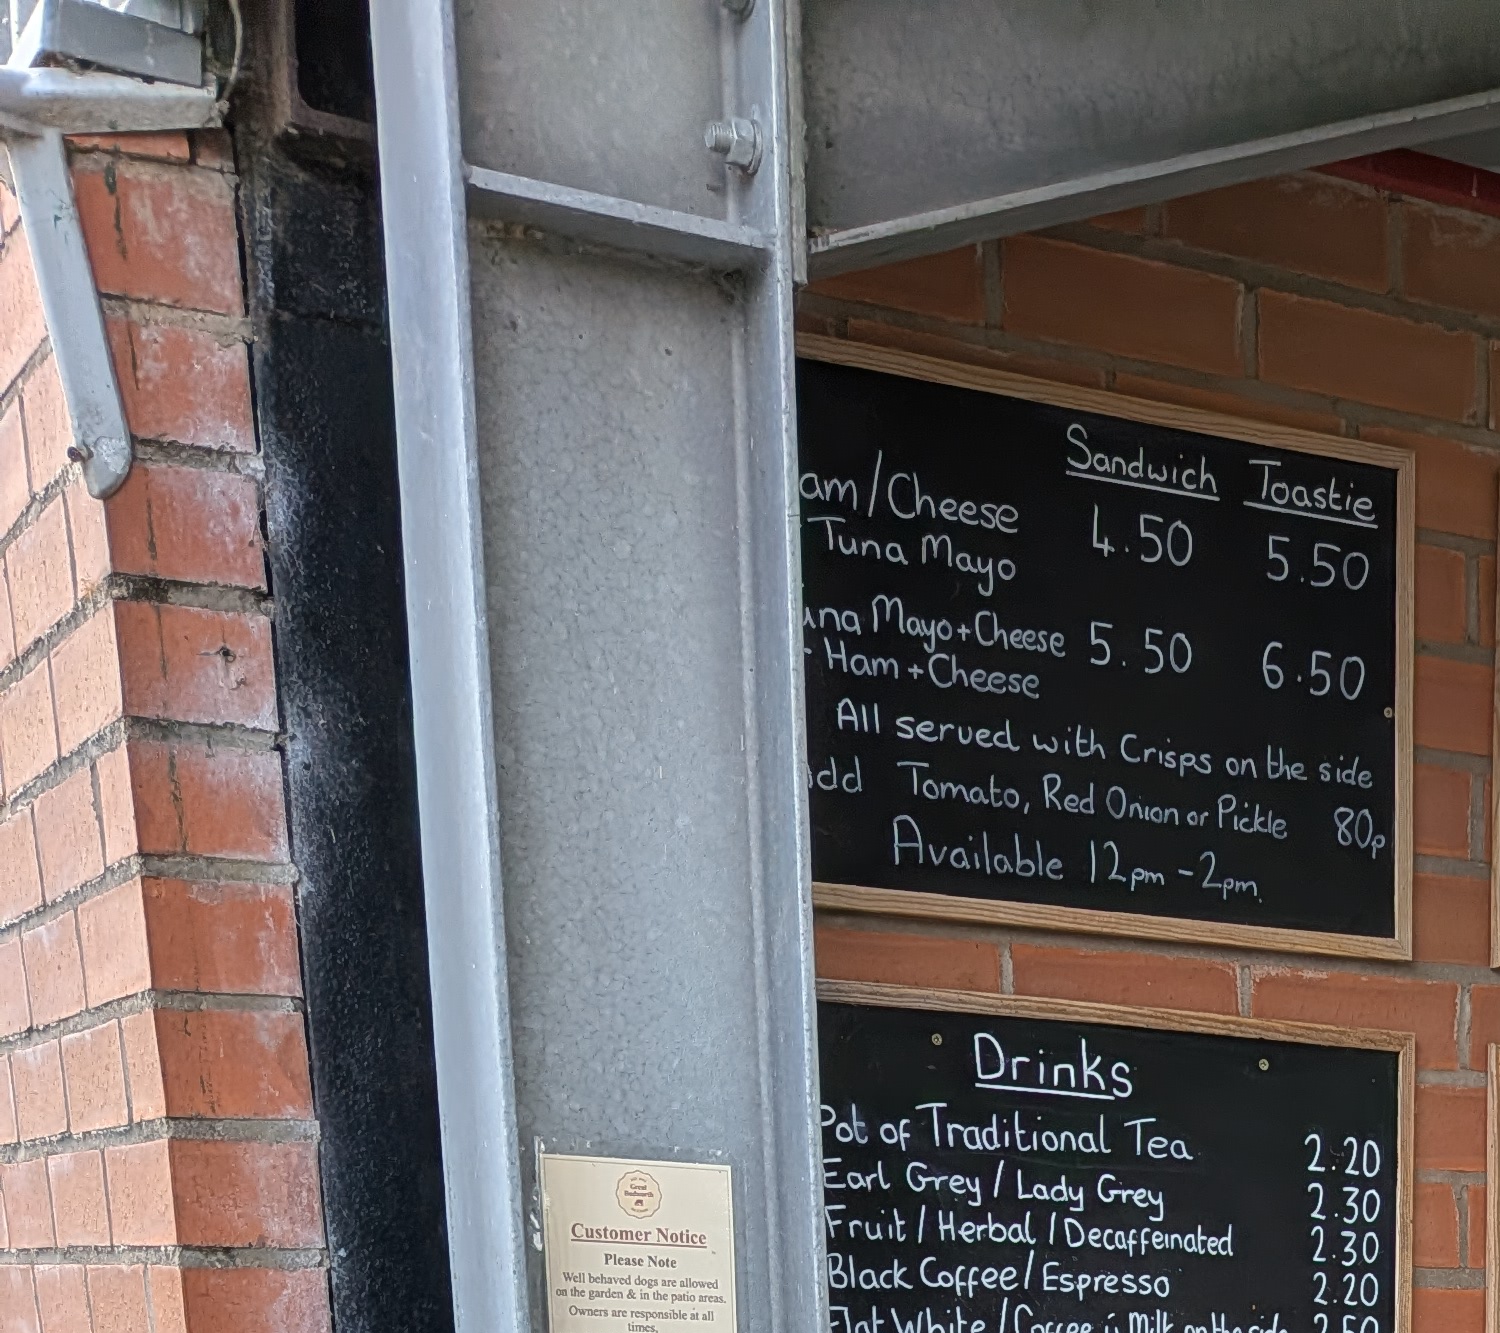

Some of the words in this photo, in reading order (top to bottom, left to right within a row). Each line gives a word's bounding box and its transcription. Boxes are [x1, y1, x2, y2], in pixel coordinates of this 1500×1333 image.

[1066, 423, 1218, 494] Sandwich
[1248, 460, 1377, 521] Toastie
[806, 516, 909, 566] Tuna
[921, 534, 1016, 597] Mayo
[1092, 503, 1193, 567] 4.50
[1266, 534, 1370, 591] 5.50
[1090, 621, 1193, 674] 5.50
[1262, 641, 1366, 701] 6.50
[836, 697, 880, 734] All
[895, 716, 1021, 752] served
[1032, 724, 1106, 760] with
[1120, 733, 1212, 777] Crisps
[1225, 757, 1258, 779] on
[1266, 744, 1308, 781] the
[1318, 754, 1373, 789] side
[973, 1032, 1134, 1098] Drinks
[820, 1104, 868, 1145] Pot
[879, 1118, 911, 1152] of
[914, 1102, 1112, 1154] Traditional
[1123, 1117, 1194, 1161] Tea
[1304, 1133, 1381, 1178] 2.20
[571, 1222, 652, 1243] Customer
[656, 1226, 707, 1245] Notice
[603, 1252, 645, 1267] Please
[647, 1255, 677, 1269] Note
[562, 1271, 586, 1284] Well
[587, 1272, 632, 1286] behaved
[633, 1274, 659, 1290] dogs
[661, 1279, 677, 1288] are
[679, 1277, 719, 1290] allowed
